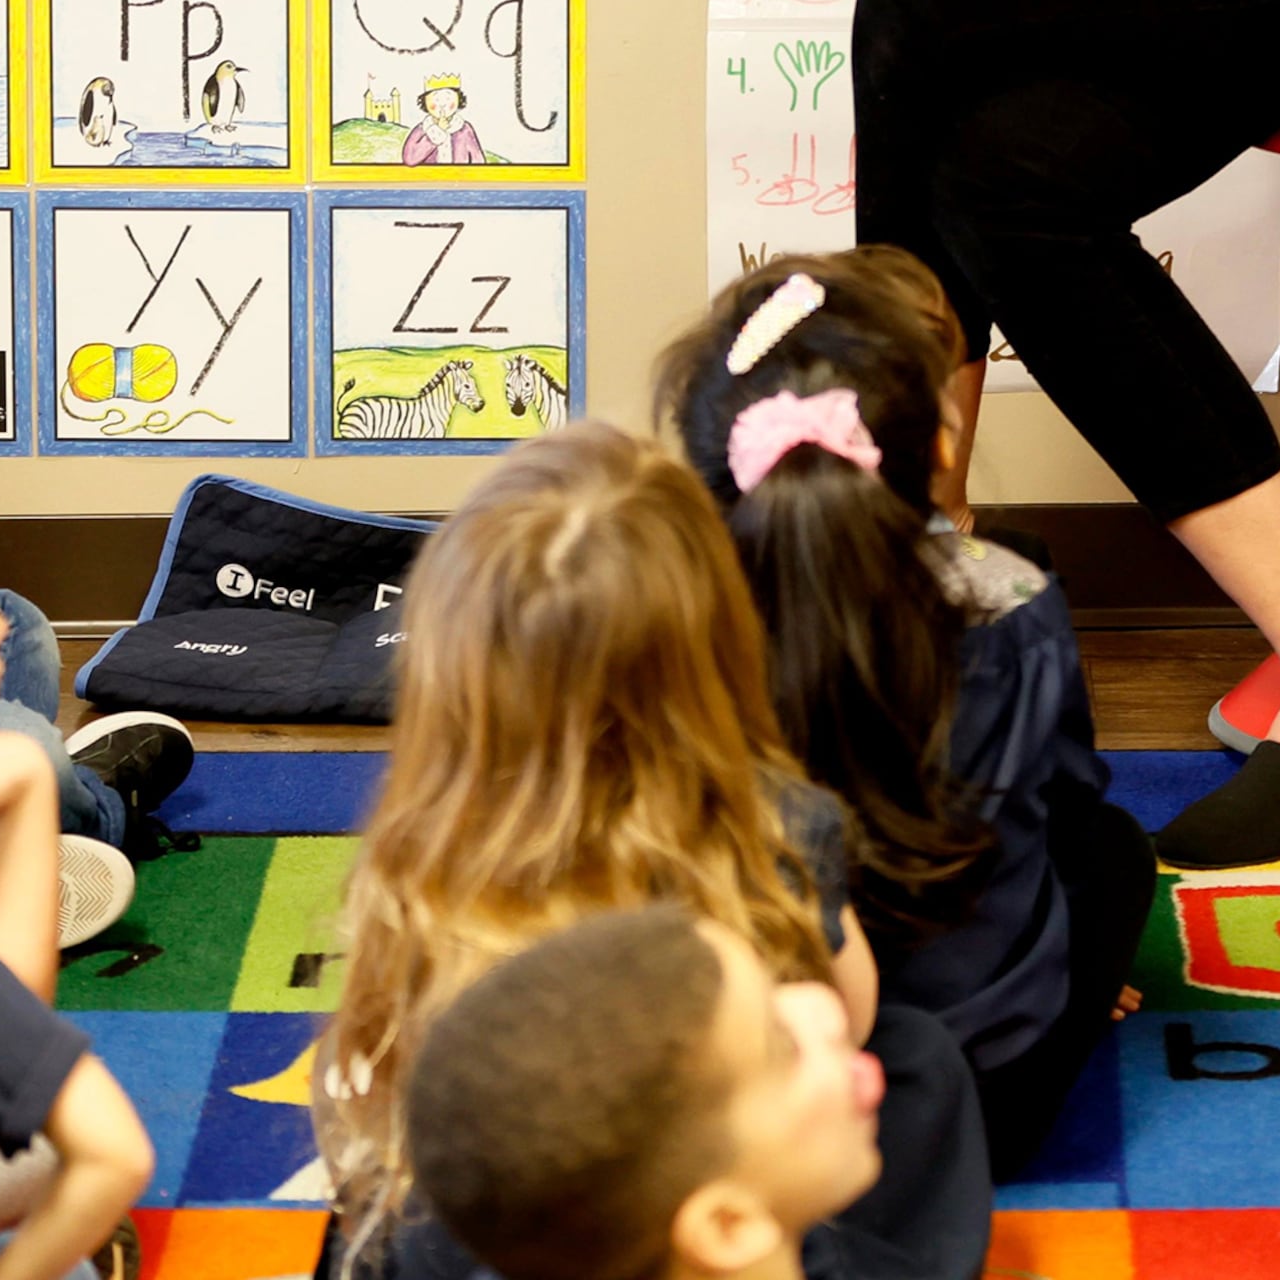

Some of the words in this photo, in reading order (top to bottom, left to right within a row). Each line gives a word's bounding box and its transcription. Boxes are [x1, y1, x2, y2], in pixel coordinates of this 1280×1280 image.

[727, 57, 755, 94] 4.
[731, 153, 761, 186] 5.
[393, 220, 512, 334] Zz
[124, 224, 263, 398] Yy
[254, 578, 316, 611] Feel
